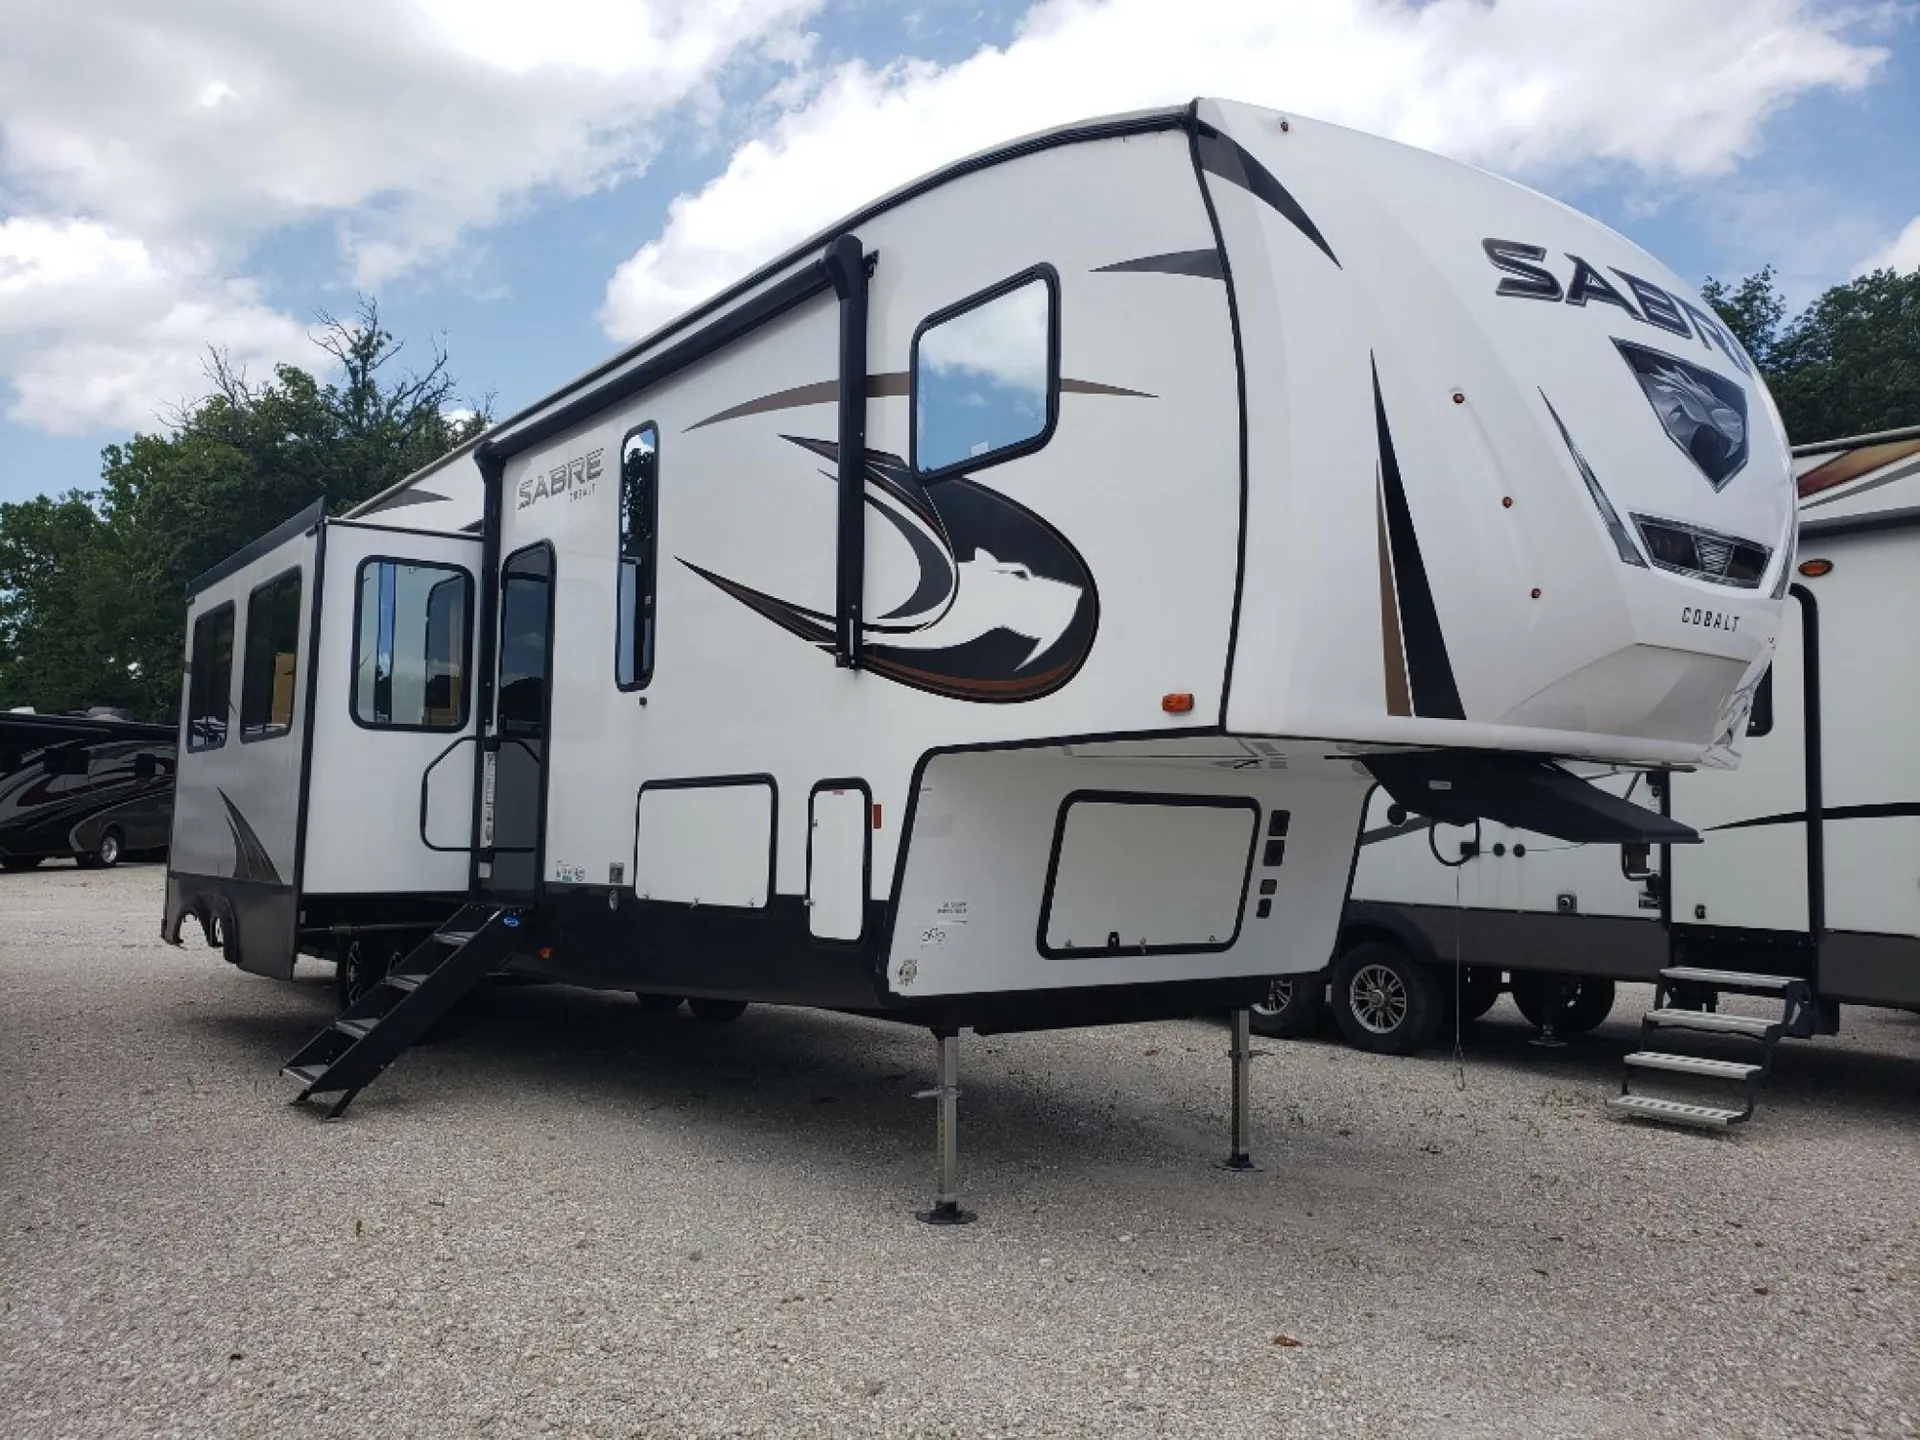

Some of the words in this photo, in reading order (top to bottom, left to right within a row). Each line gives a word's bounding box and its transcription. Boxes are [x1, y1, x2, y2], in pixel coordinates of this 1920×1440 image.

[1481, 237, 1754, 381] SABR
[517, 447, 605, 511] SABRE
[1681, 606, 1740, 633] COBALT
